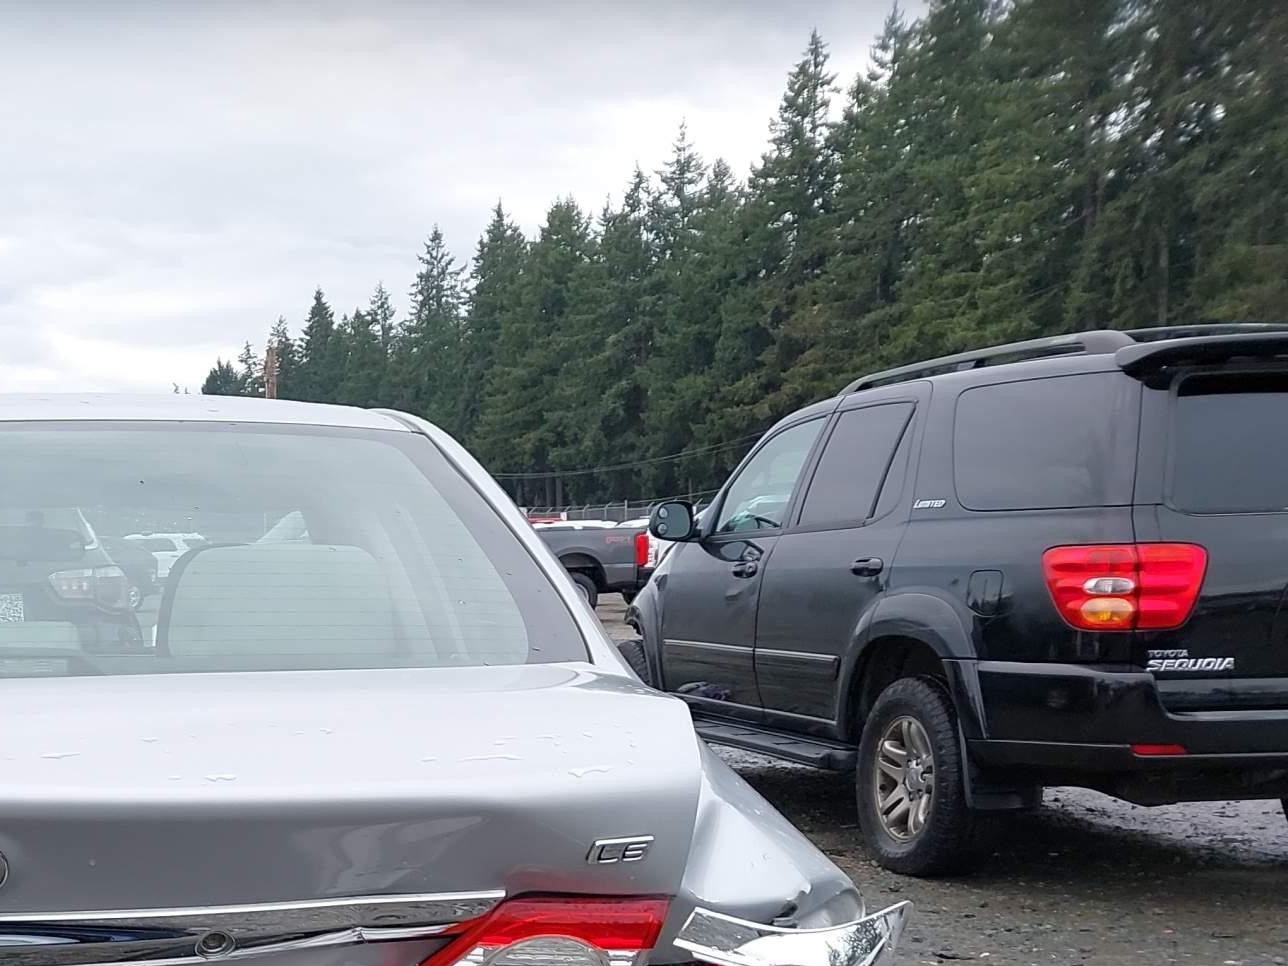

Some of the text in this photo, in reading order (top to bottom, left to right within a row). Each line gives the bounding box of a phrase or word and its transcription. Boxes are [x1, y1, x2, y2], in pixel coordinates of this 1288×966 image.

[1147, 649, 1189, 658] TOYOTA
[1145, 657, 1235, 671] SEQUOIA
[585, 834, 655, 864] LE
